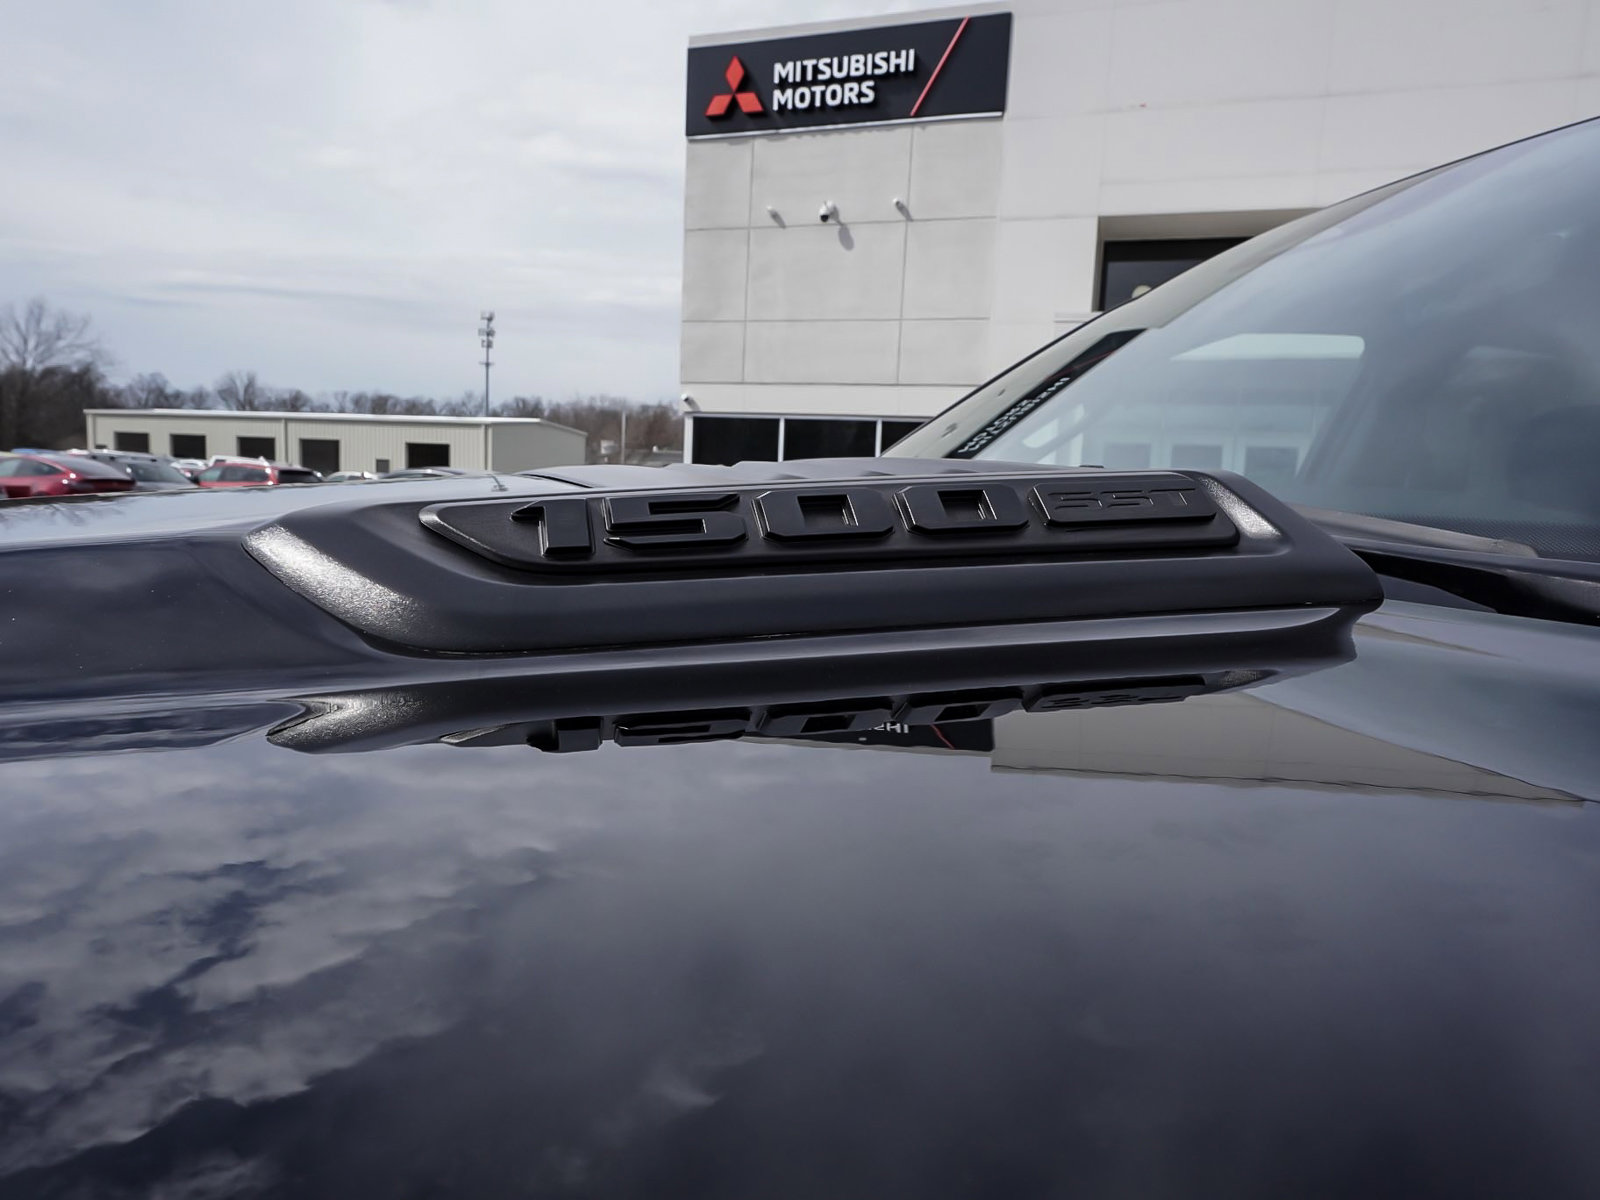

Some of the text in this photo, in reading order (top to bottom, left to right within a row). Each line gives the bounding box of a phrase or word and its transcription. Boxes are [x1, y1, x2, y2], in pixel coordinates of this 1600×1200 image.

[772, 48, 916, 84] MITSUBISHI
[772, 80, 876, 112] MOTORS
[509, 484, 1197, 557] 1500 SST
